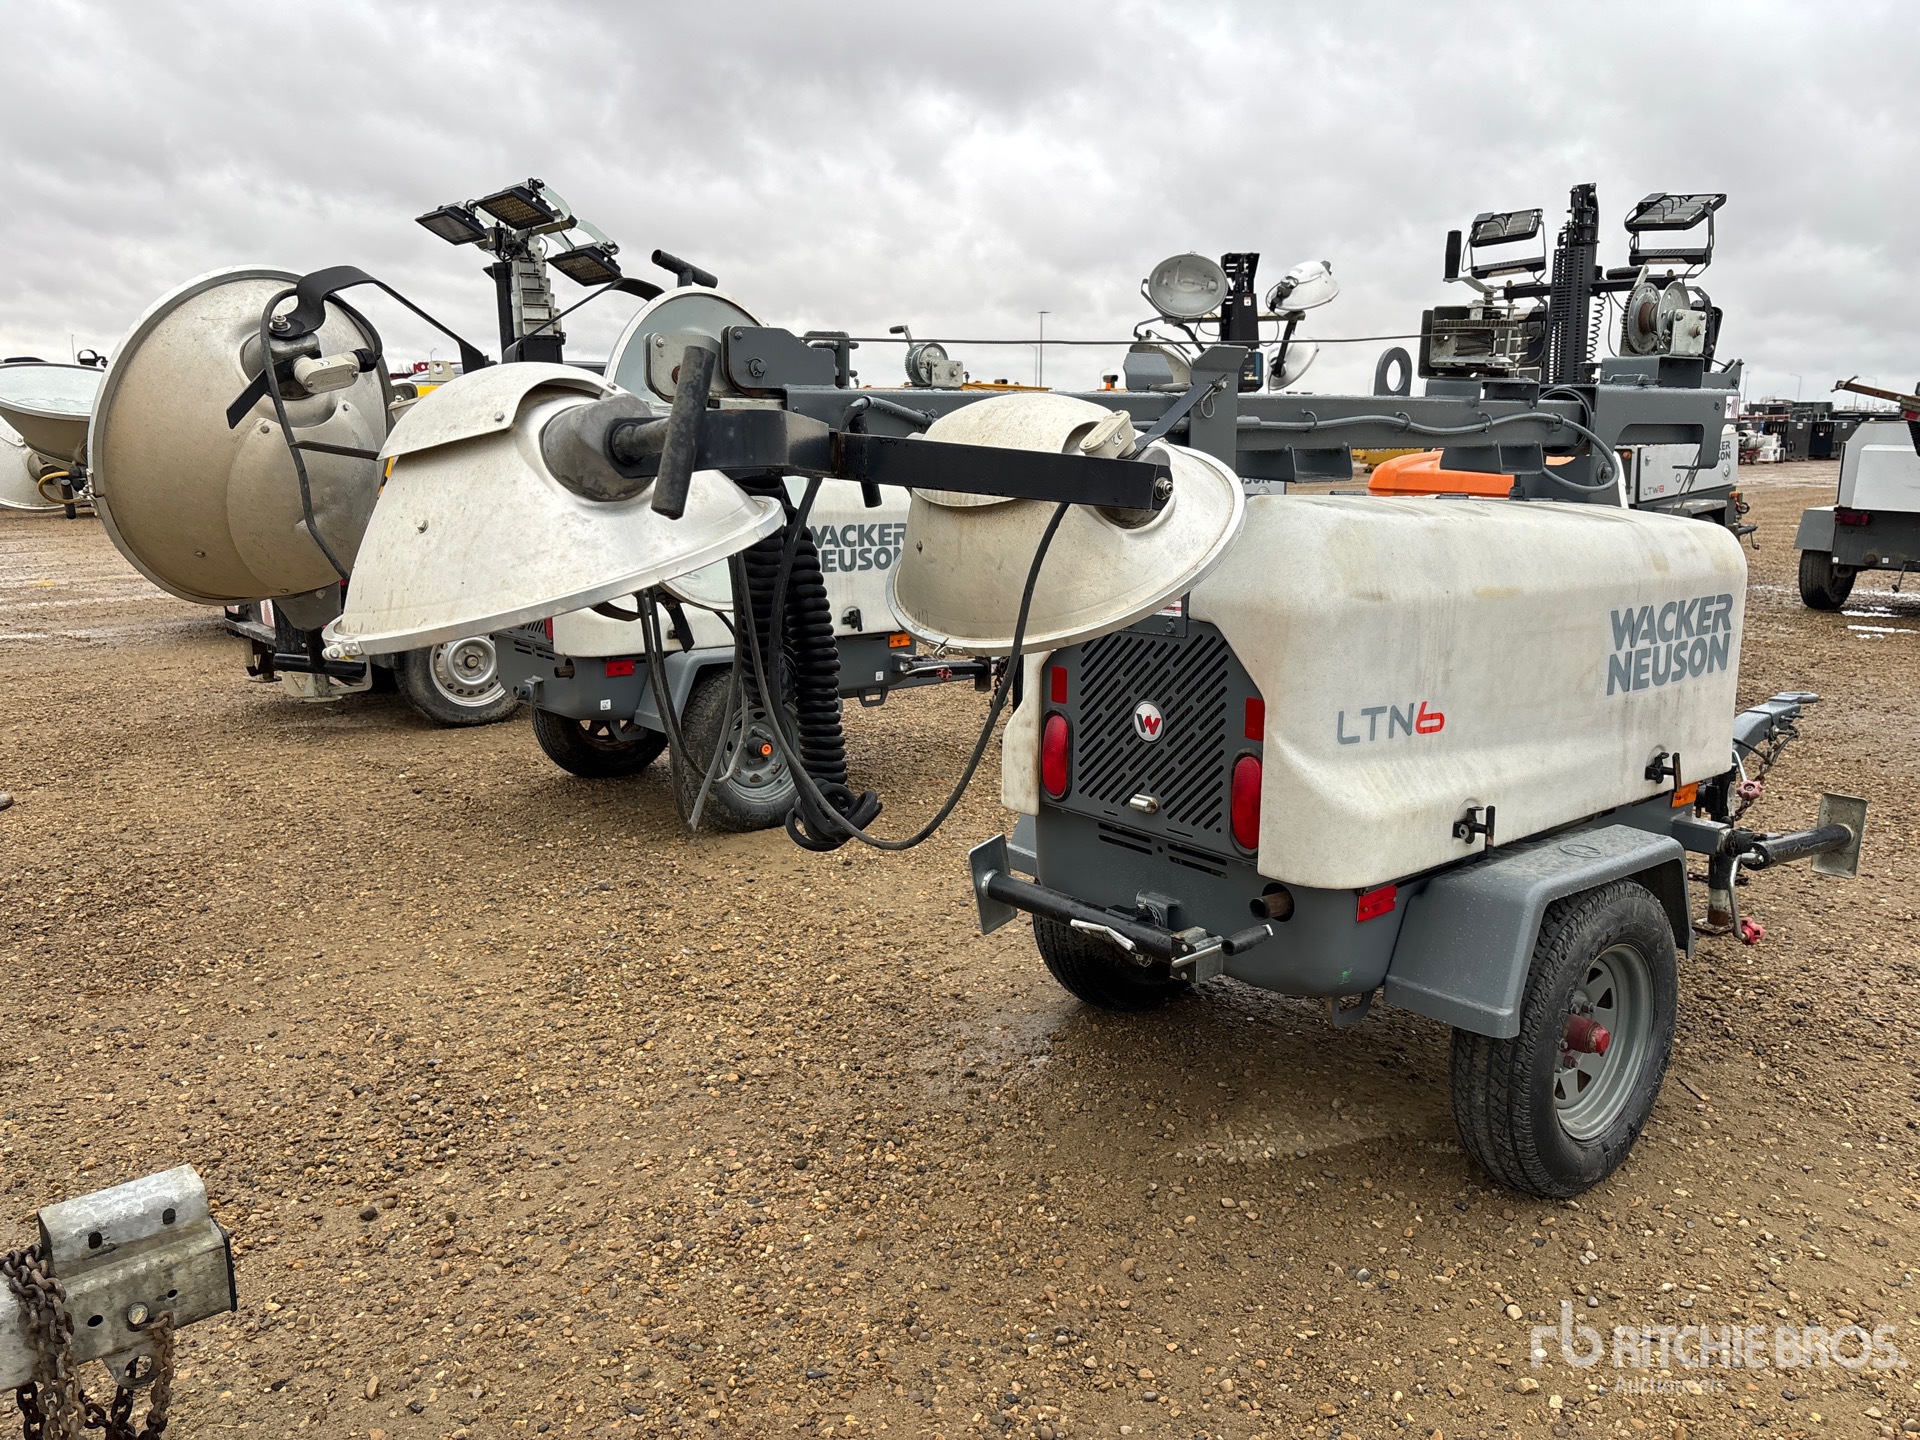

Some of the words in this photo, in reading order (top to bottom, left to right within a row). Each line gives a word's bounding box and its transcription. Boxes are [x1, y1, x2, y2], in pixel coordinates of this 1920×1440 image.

[1610, 593, 1733, 651] WACKER
[1606, 632, 1731, 696] NEUSON
[1336, 701, 1445, 745] LTN6
